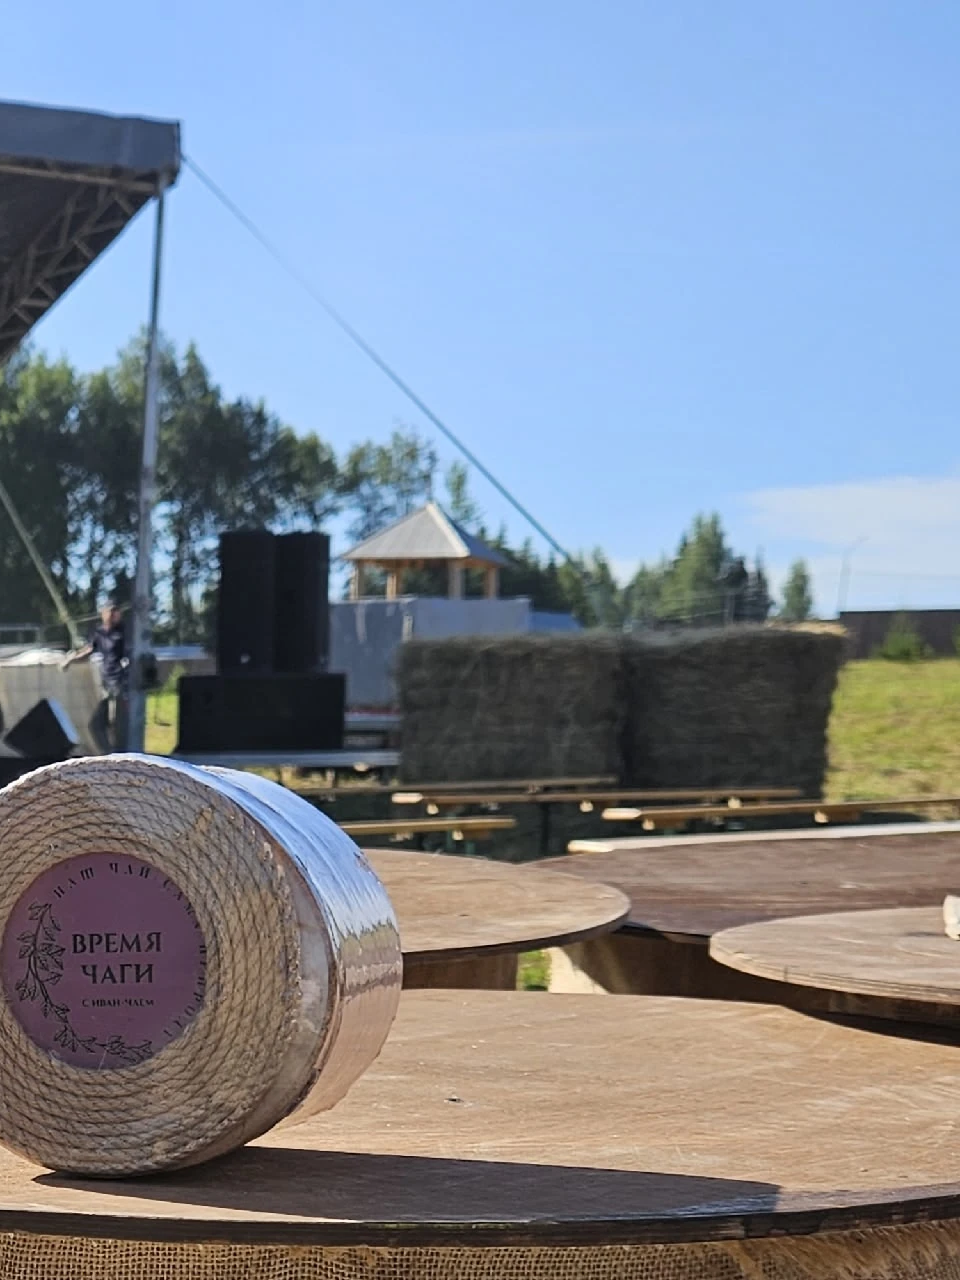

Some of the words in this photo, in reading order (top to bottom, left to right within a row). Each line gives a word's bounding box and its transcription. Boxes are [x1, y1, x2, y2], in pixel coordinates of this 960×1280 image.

[53, 867, 95, 899] НАШ
[71, 931, 162, 954] ВРЕМЯ
[80, 964, 154, 985] ЧАГИ
